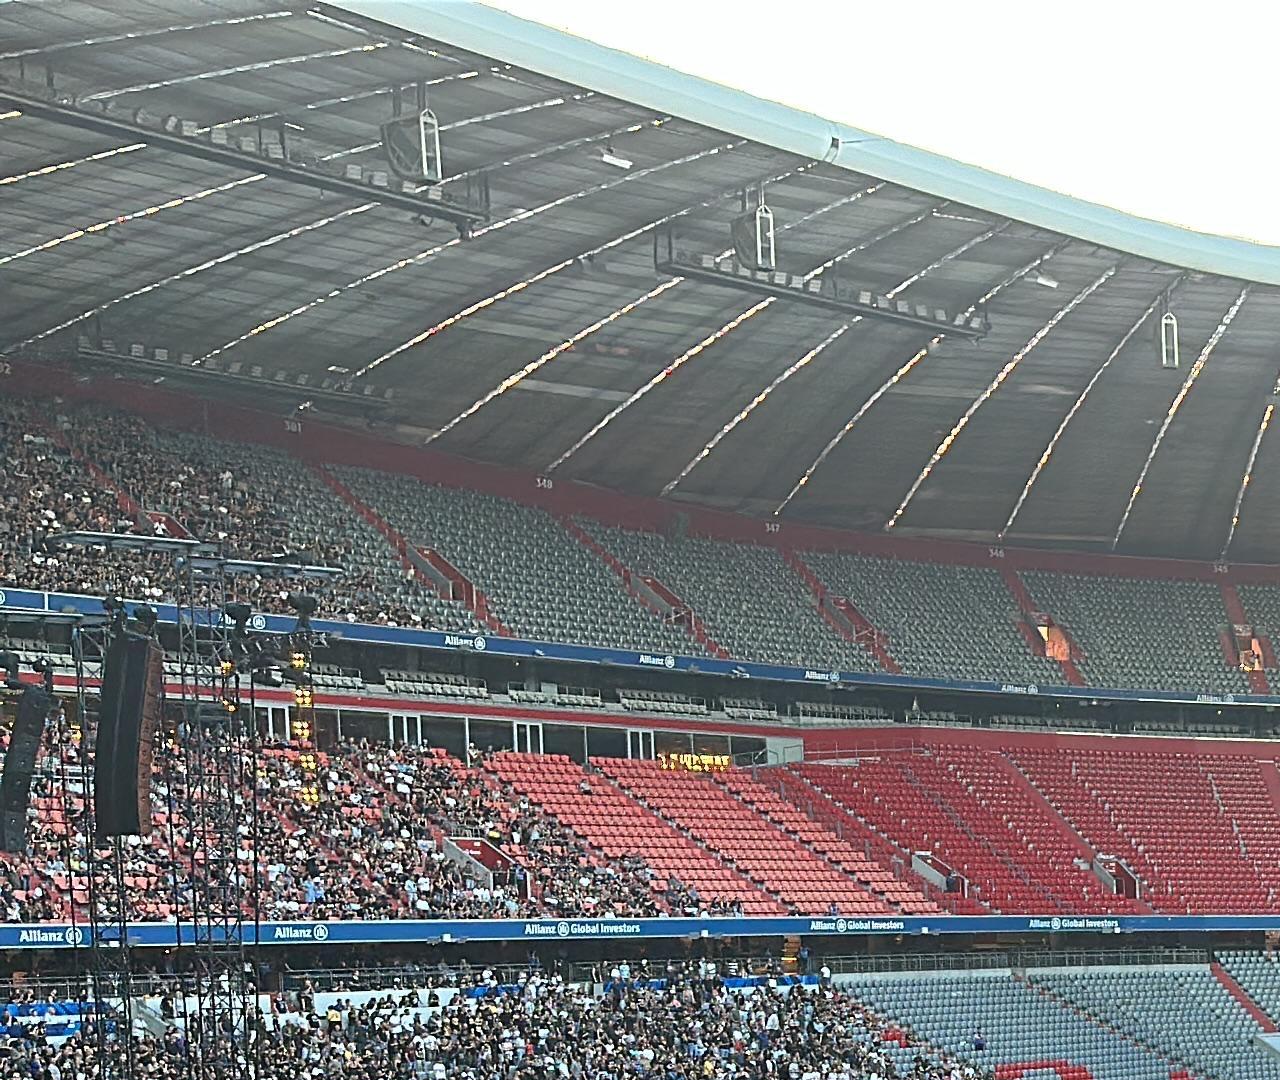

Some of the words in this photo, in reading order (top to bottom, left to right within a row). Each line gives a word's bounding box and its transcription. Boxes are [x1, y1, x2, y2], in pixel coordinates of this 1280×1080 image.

[536, 478, 553, 490] 348
[765, 522, 780, 534] 347
[445, 635, 474, 647] Allianz
[639, 654, 664, 665] Allianz
[805, 671, 829, 681] Allianz
[1001, 684, 1027, 693] Allianz
[525, 923, 556, 935] Allianz
[571, 922, 599, 934] Global
[600, 922, 640, 933] Investors
[811, 921, 836, 931] Allianz
[847, 920, 869, 930] Global
[871, 919, 904, 930] Investors
[1029, 919, 1051, 929] Allianz
[1062, 919, 1084, 929] Global
[1085, 919, 1118, 929] Investors
[20, 926, 64, 943] Allianz
[275, 926, 311, 939] Allianz
